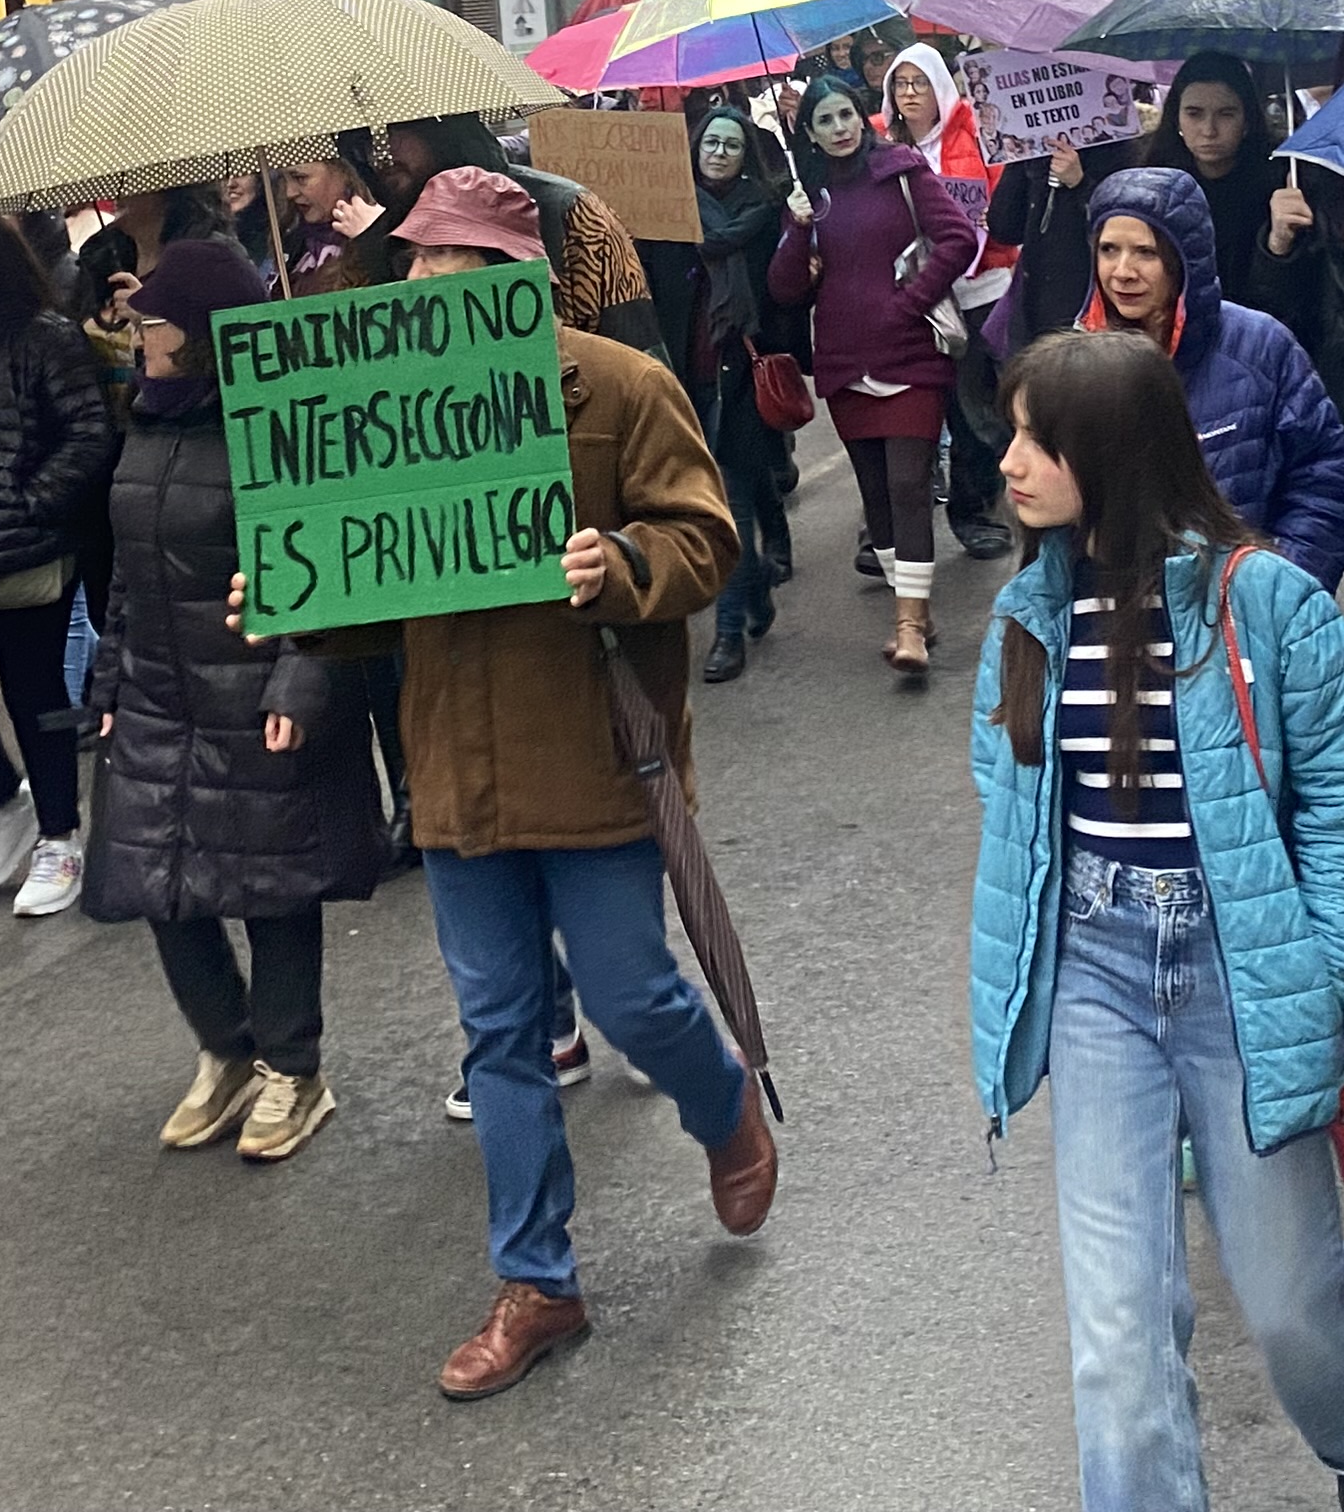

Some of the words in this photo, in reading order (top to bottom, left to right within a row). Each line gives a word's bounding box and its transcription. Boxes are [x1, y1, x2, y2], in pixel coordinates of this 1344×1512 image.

[994, 70, 1031, 90] ELLAS
[1032, 66, 1050, 83] NO
[1011, 93, 1026, 109] EN
[1028, 88, 1044, 105] TU
[1046, 81, 1084, 101] LIBRO
[1025, 113, 1041, 128] DE
[1042, 104, 1080, 125] TEXTO
[219, 294, 451, 386] FEMINISMO
[463, 278, 544, 344] NO
[229, 367, 566, 490] INTERSECCIONAL
[254, 519, 319, 617] ES
[341, 480, 573, 596] PRIVILEGIO
